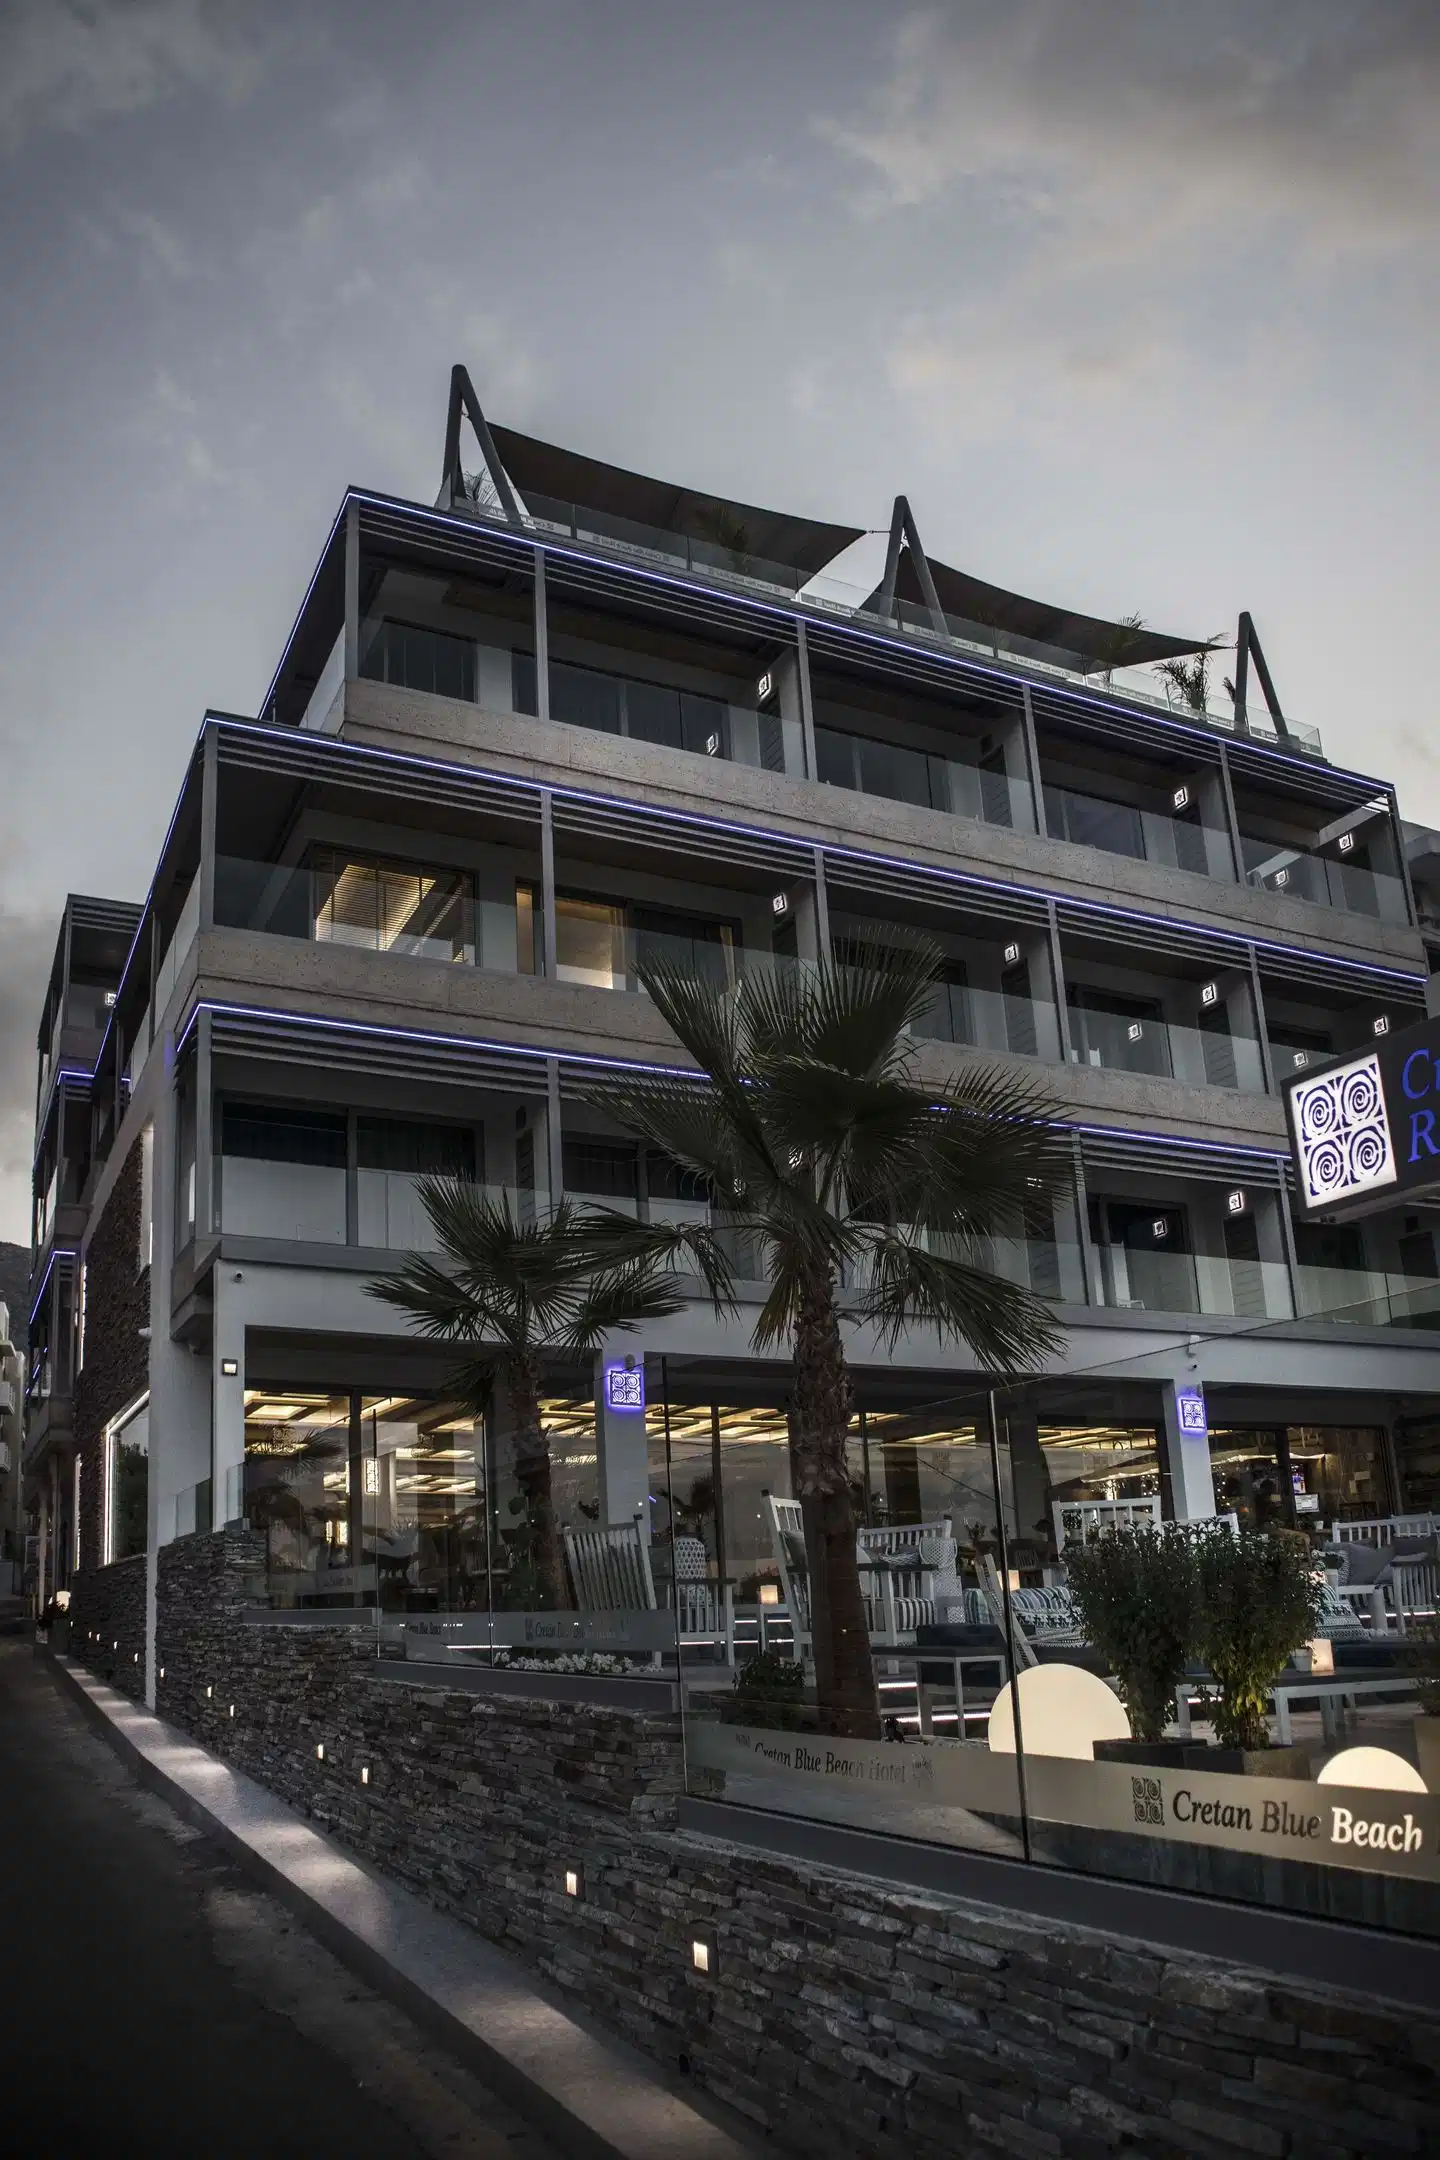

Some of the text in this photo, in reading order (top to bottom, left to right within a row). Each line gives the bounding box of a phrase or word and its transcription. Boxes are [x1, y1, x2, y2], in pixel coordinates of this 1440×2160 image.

[1407, 1108, 1440, 1163] R
[795, 1747, 821, 1773] Blue
[825, 1751, 864, 1779] Beach
[1172, 1790, 1253, 1831] Cretan
[1260, 1800, 1322, 1840] Blue
[1330, 1806, 1423, 1853] Beach
